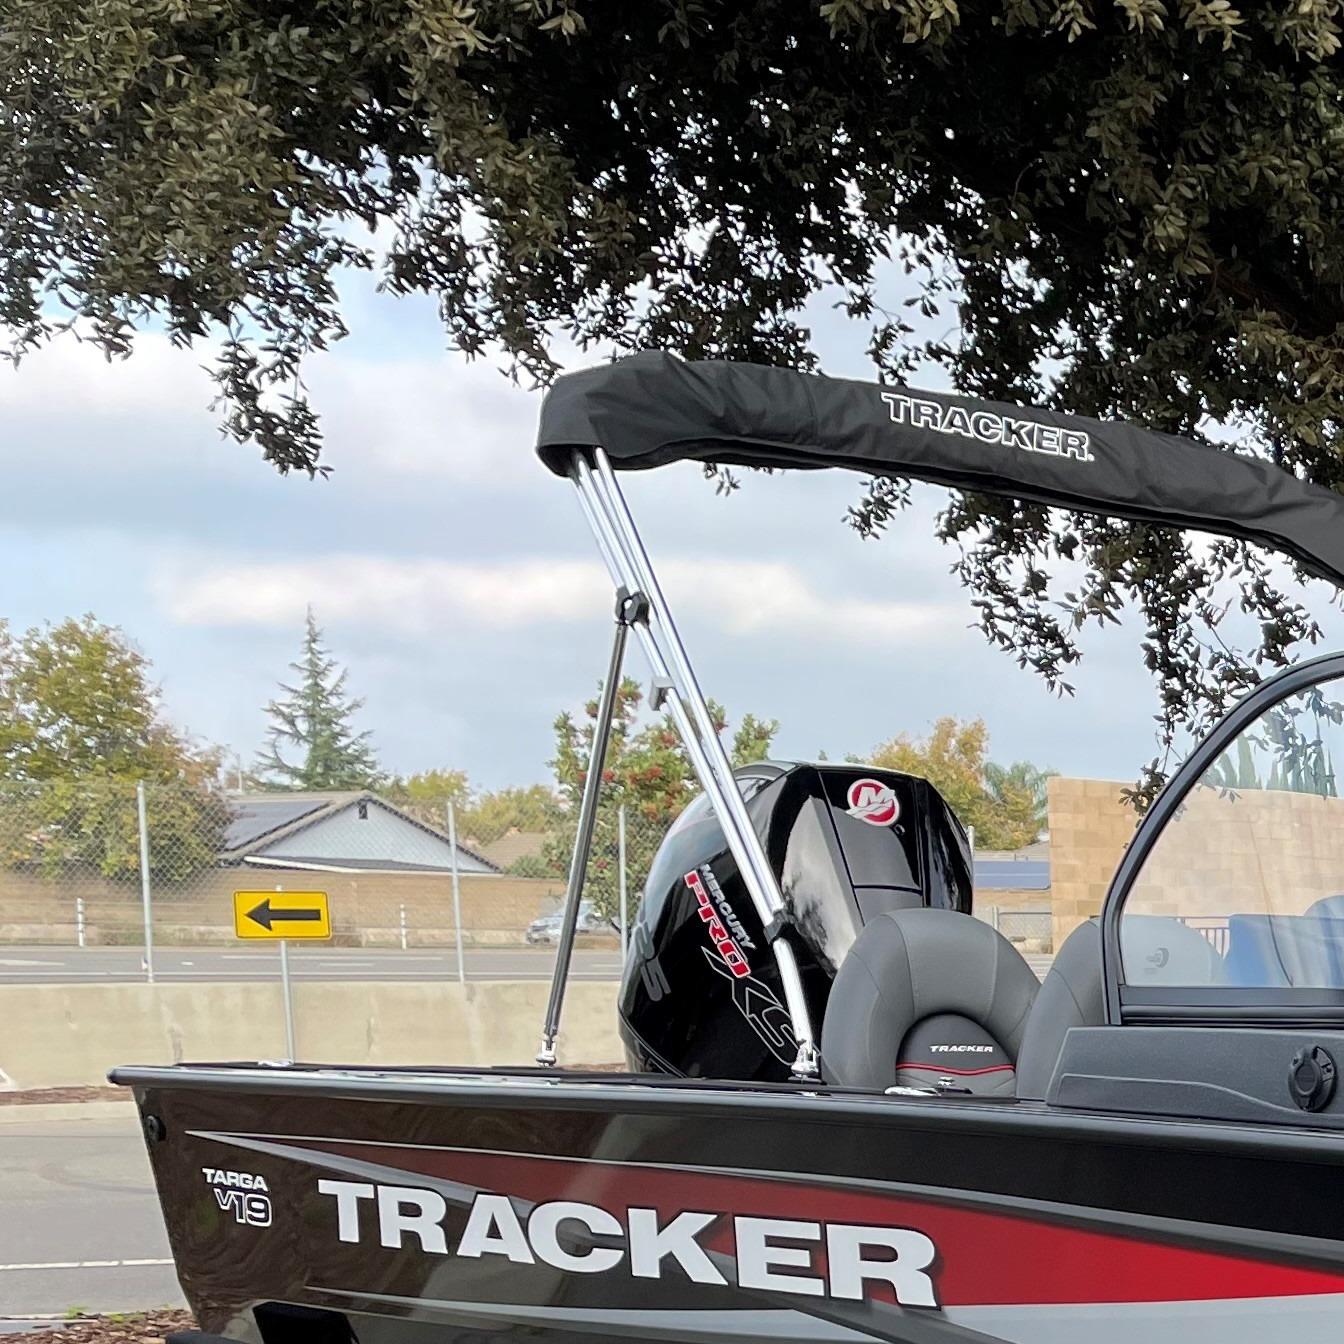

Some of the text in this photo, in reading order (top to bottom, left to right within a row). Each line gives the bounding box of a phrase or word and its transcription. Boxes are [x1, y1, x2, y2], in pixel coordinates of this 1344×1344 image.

[881, 392, 1089, 461] TRACKER
[684, 870, 751, 978] PRO
[698, 863, 757, 950] MERCURY
[929, 1045, 993, 1053] TRACKER
[202, 1167, 269, 1192] TARGA
[213, 1187, 272, 1227] V19
[318, 1179, 938, 1307] TRACKER
